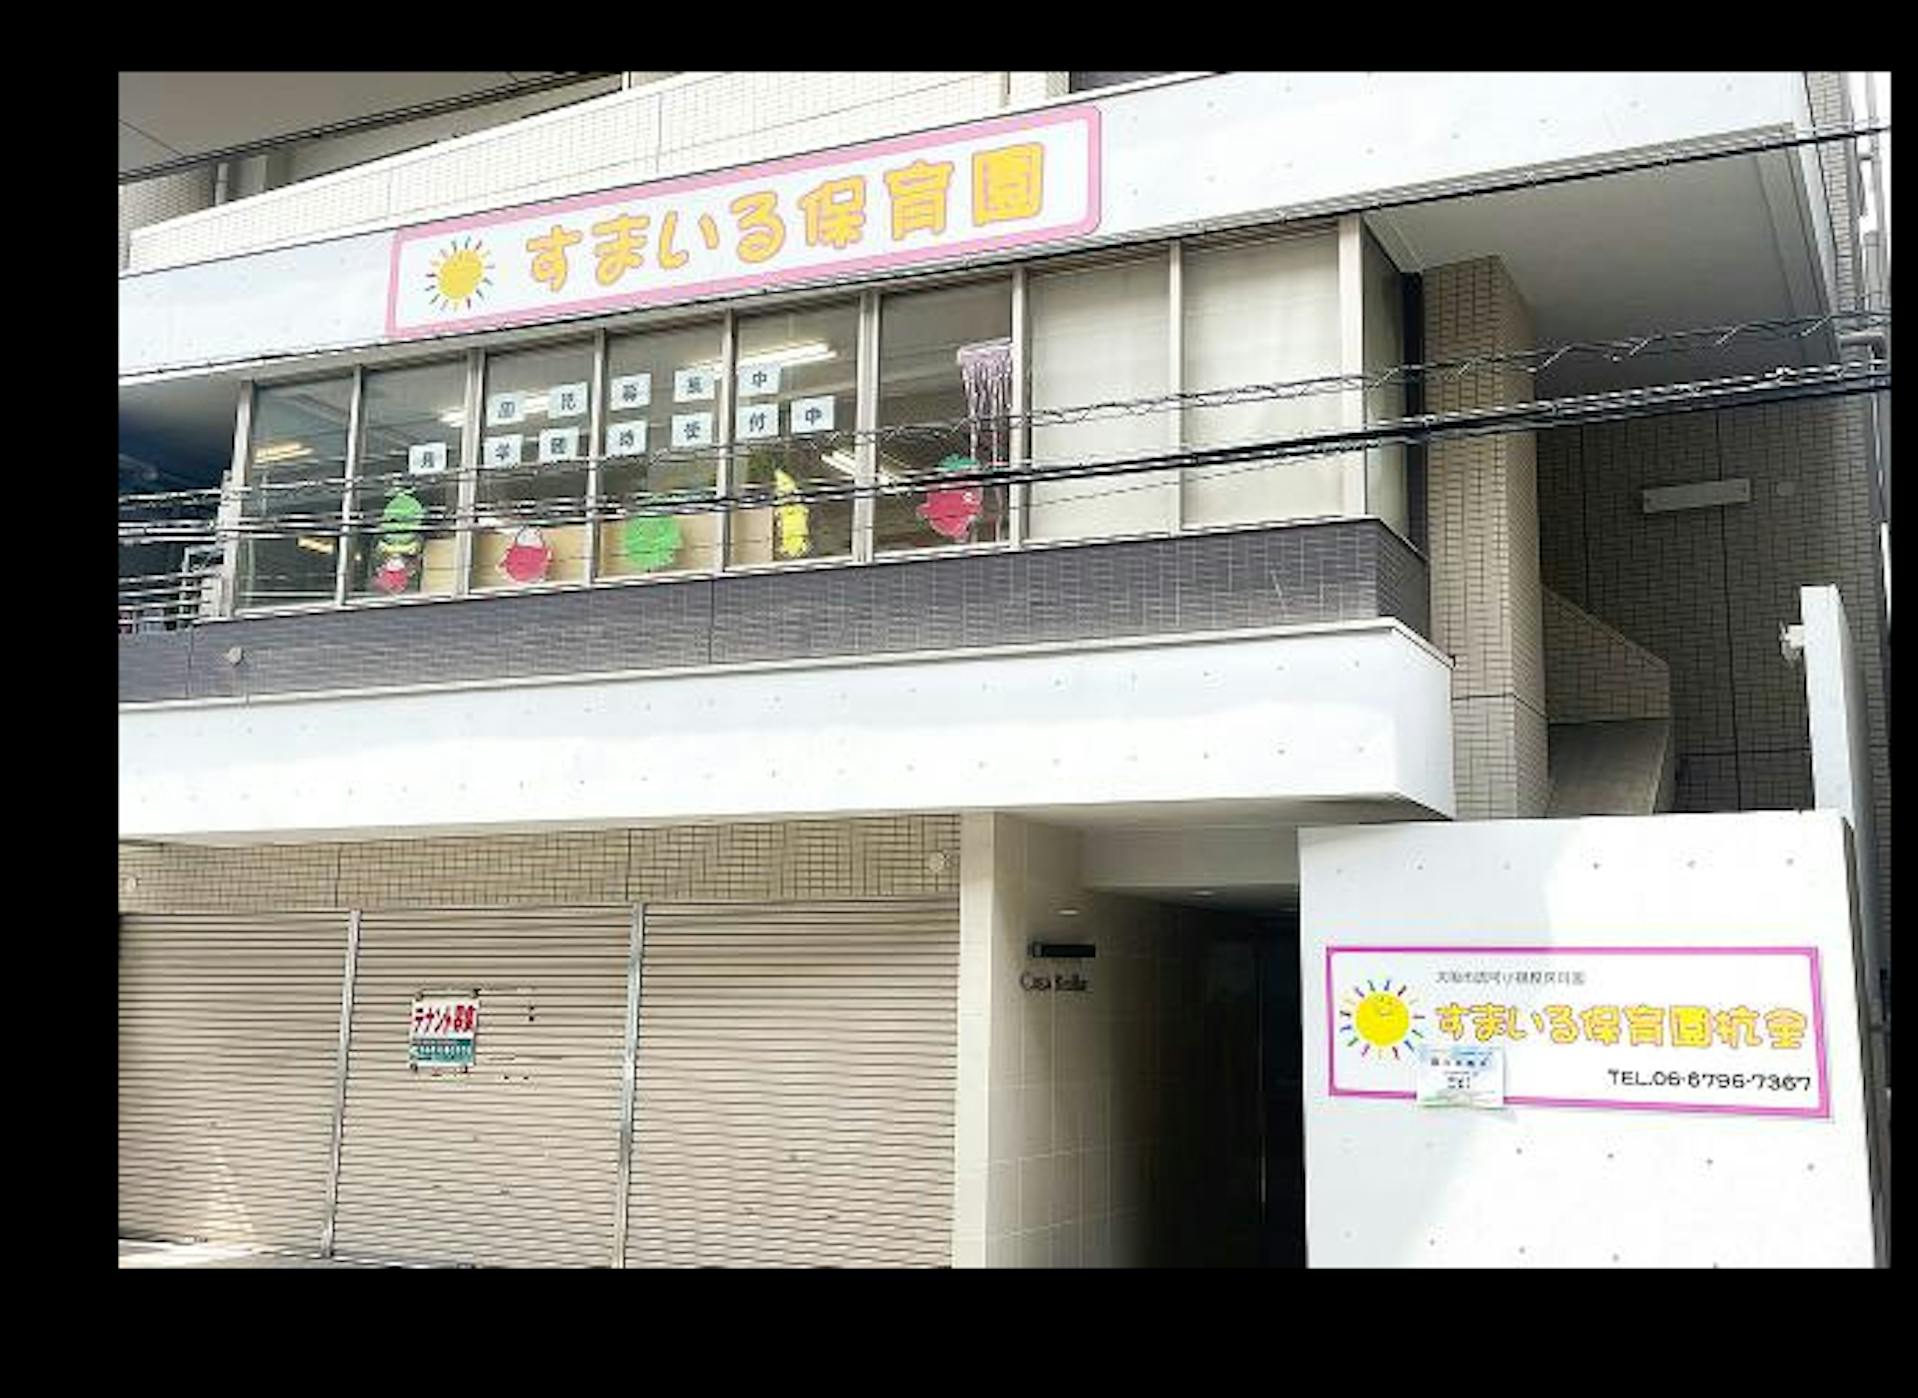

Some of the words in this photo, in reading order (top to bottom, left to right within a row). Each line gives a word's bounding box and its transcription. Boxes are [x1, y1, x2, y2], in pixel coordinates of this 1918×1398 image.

[525, 142, 1046, 291] すまいる保育園
[1436, 1004, 1808, 1049] すまいる保育園杭全
